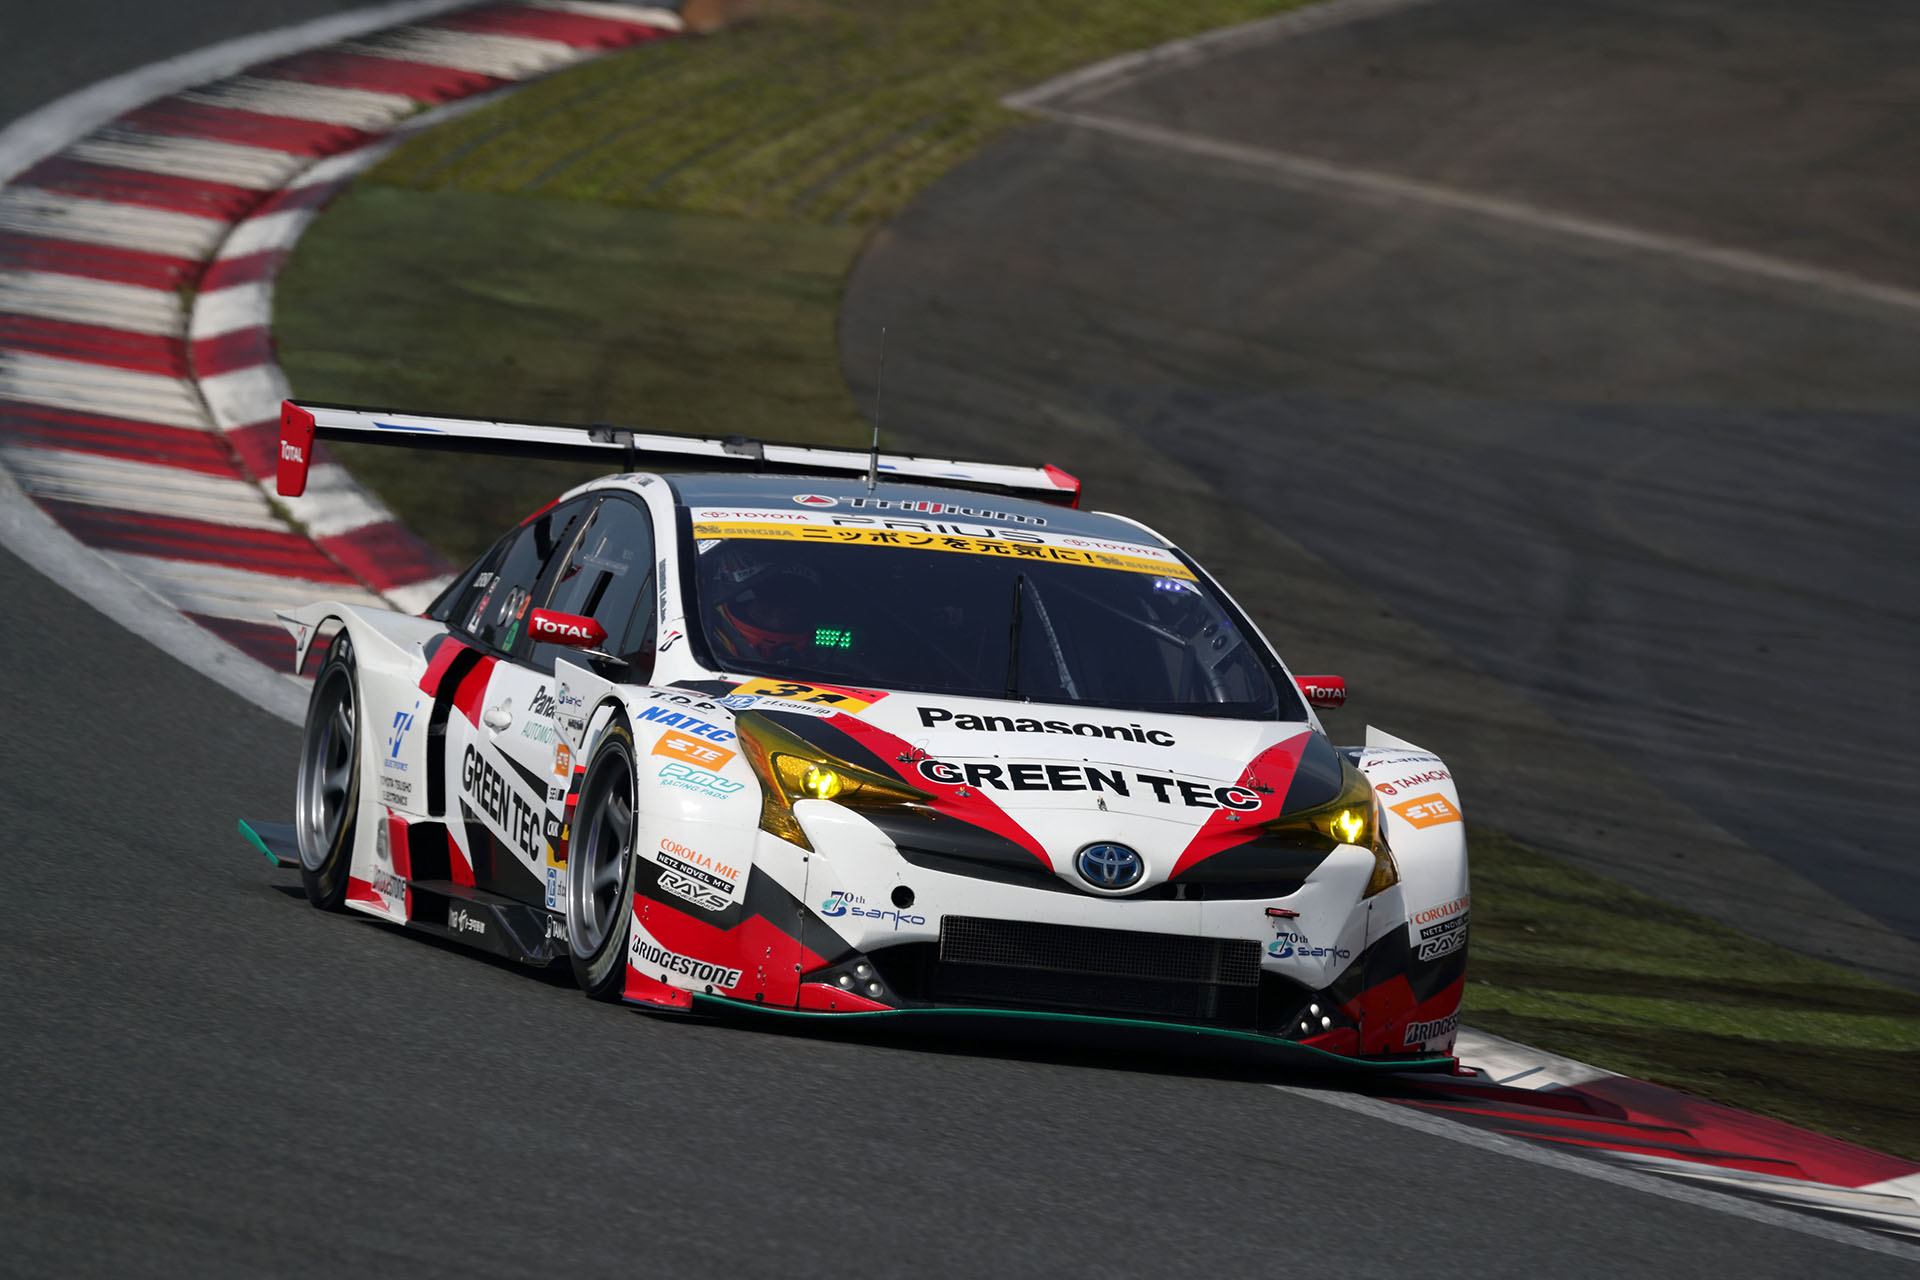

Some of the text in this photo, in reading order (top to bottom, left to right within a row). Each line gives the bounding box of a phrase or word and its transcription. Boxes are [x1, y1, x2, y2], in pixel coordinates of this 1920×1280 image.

[280, 440, 303, 463] TOTAL
[732, 511, 808, 521] TOYOTA
[724, 527, 795, 537] SINGHA
[831, 515, 1045, 544] PRIUS
[1091, 541, 1165, 558] TOYOTA
[534, 616, 593, 639] TOTAL
[528, 685, 555, 719] Pana
[762, 699, 832, 715] zf.com/jp
[636, 706, 737, 742] NATEC
[916, 706, 1176, 748] Panasonic
[660, 779, 729, 801] RACING PADS
[917, 759, 1263, 811] GREEN TEC
[1393, 770, 1452, 789] TAMACHI
[462, 743, 541, 862] GREEN TEC
[658, 853, 679, 869] NETZ
[679, 863, 710, 883] NOVEL
[660, 837, 742, 883] COROLLA MIE
[658, 872, 730, 909] RAYS
[851, 905, 926, 931] sanko
[1415, 900, 1460, 925] COROLLA
[1422, 925, 1443, 938] NETZ
[632, 934, 740, 988] BRIDGESTONE
[1298, 945, 1350, 968] sanko
